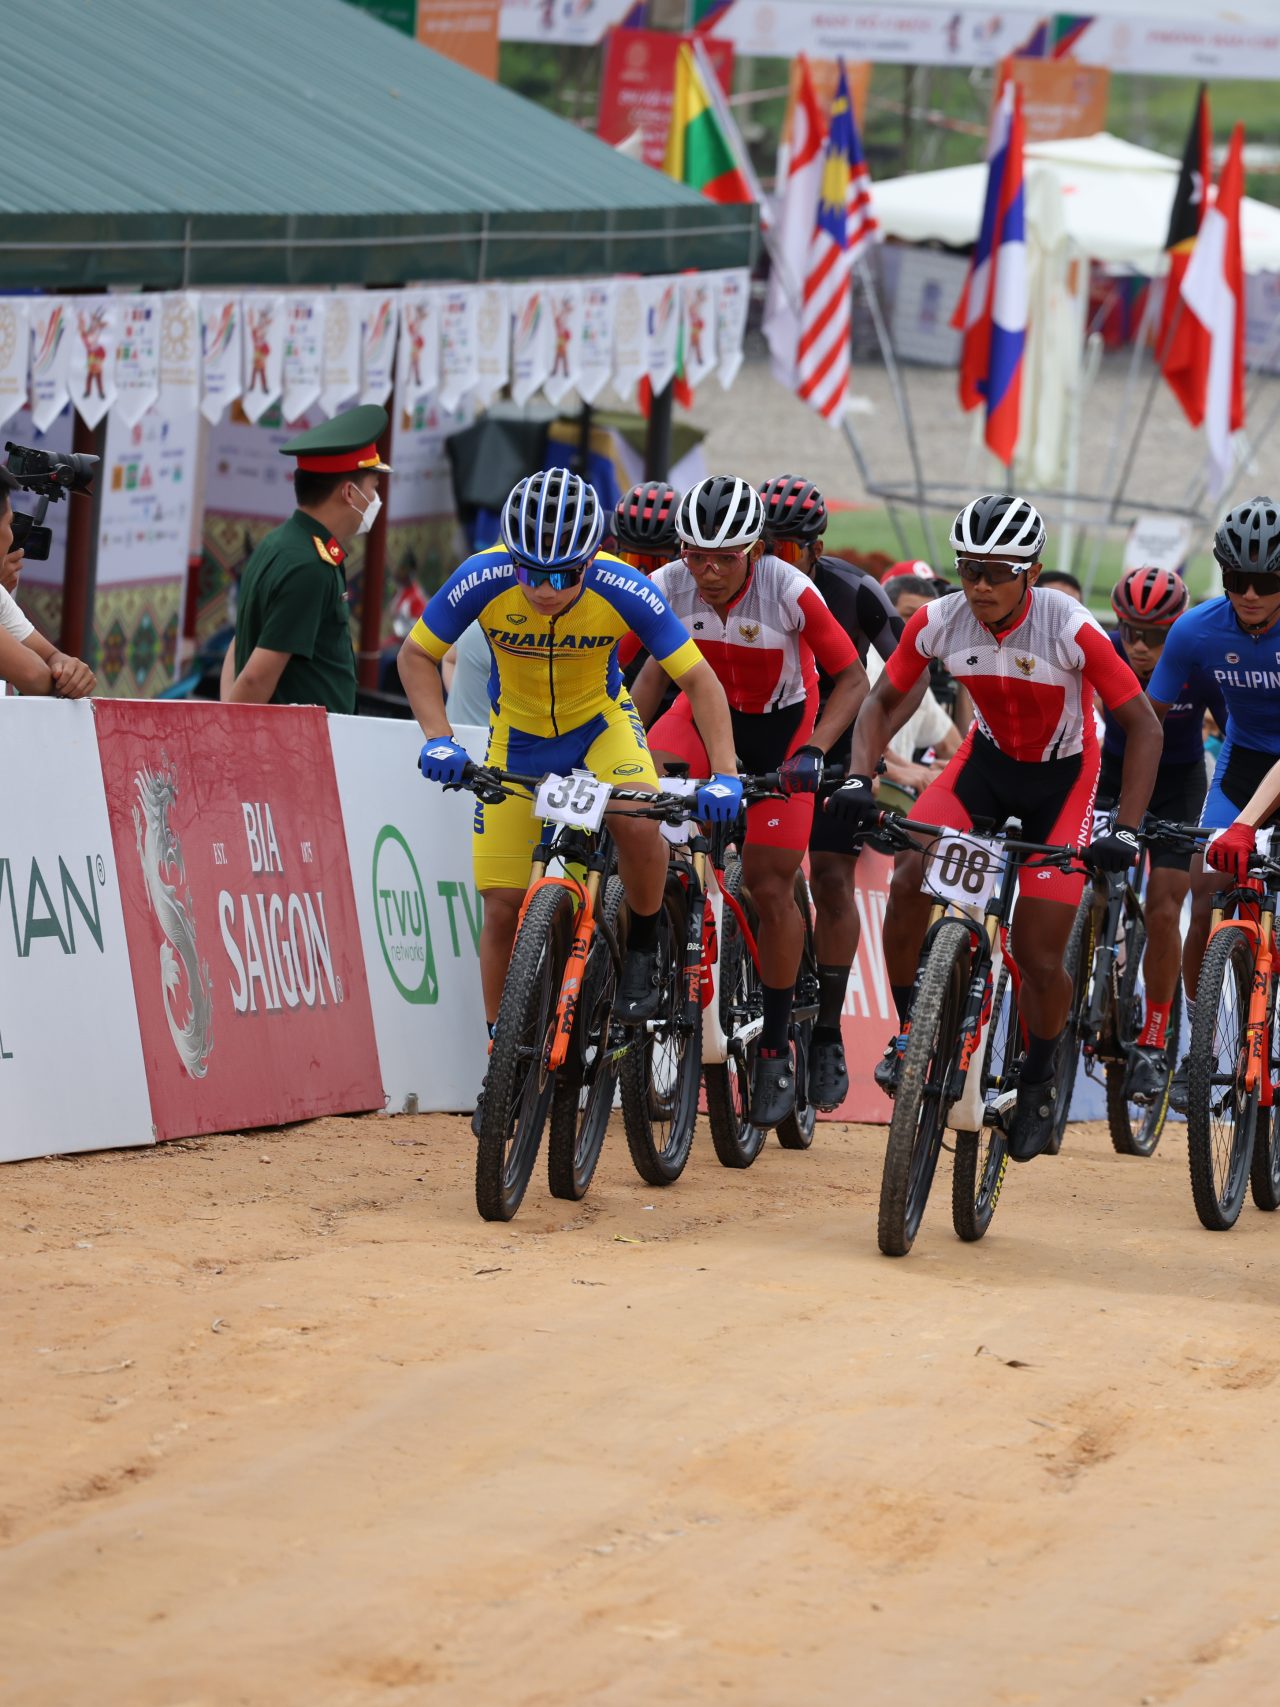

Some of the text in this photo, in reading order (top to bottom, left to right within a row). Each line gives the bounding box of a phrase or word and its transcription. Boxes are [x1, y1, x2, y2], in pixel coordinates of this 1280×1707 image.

[447, 564, 514, 608] THAILAND
[595, 569, 666, 616] THAILAND
[487, 628, 614, 650] THAILAND
[546, 777, 598, 816] 35
[241, 803, 284, 872] BIA
[939, 842, 991, 894] 08
[379, 889, 422, 937] TVU
[437, 880, 484, 958] TV
[390, 943, 425, 962] networks
